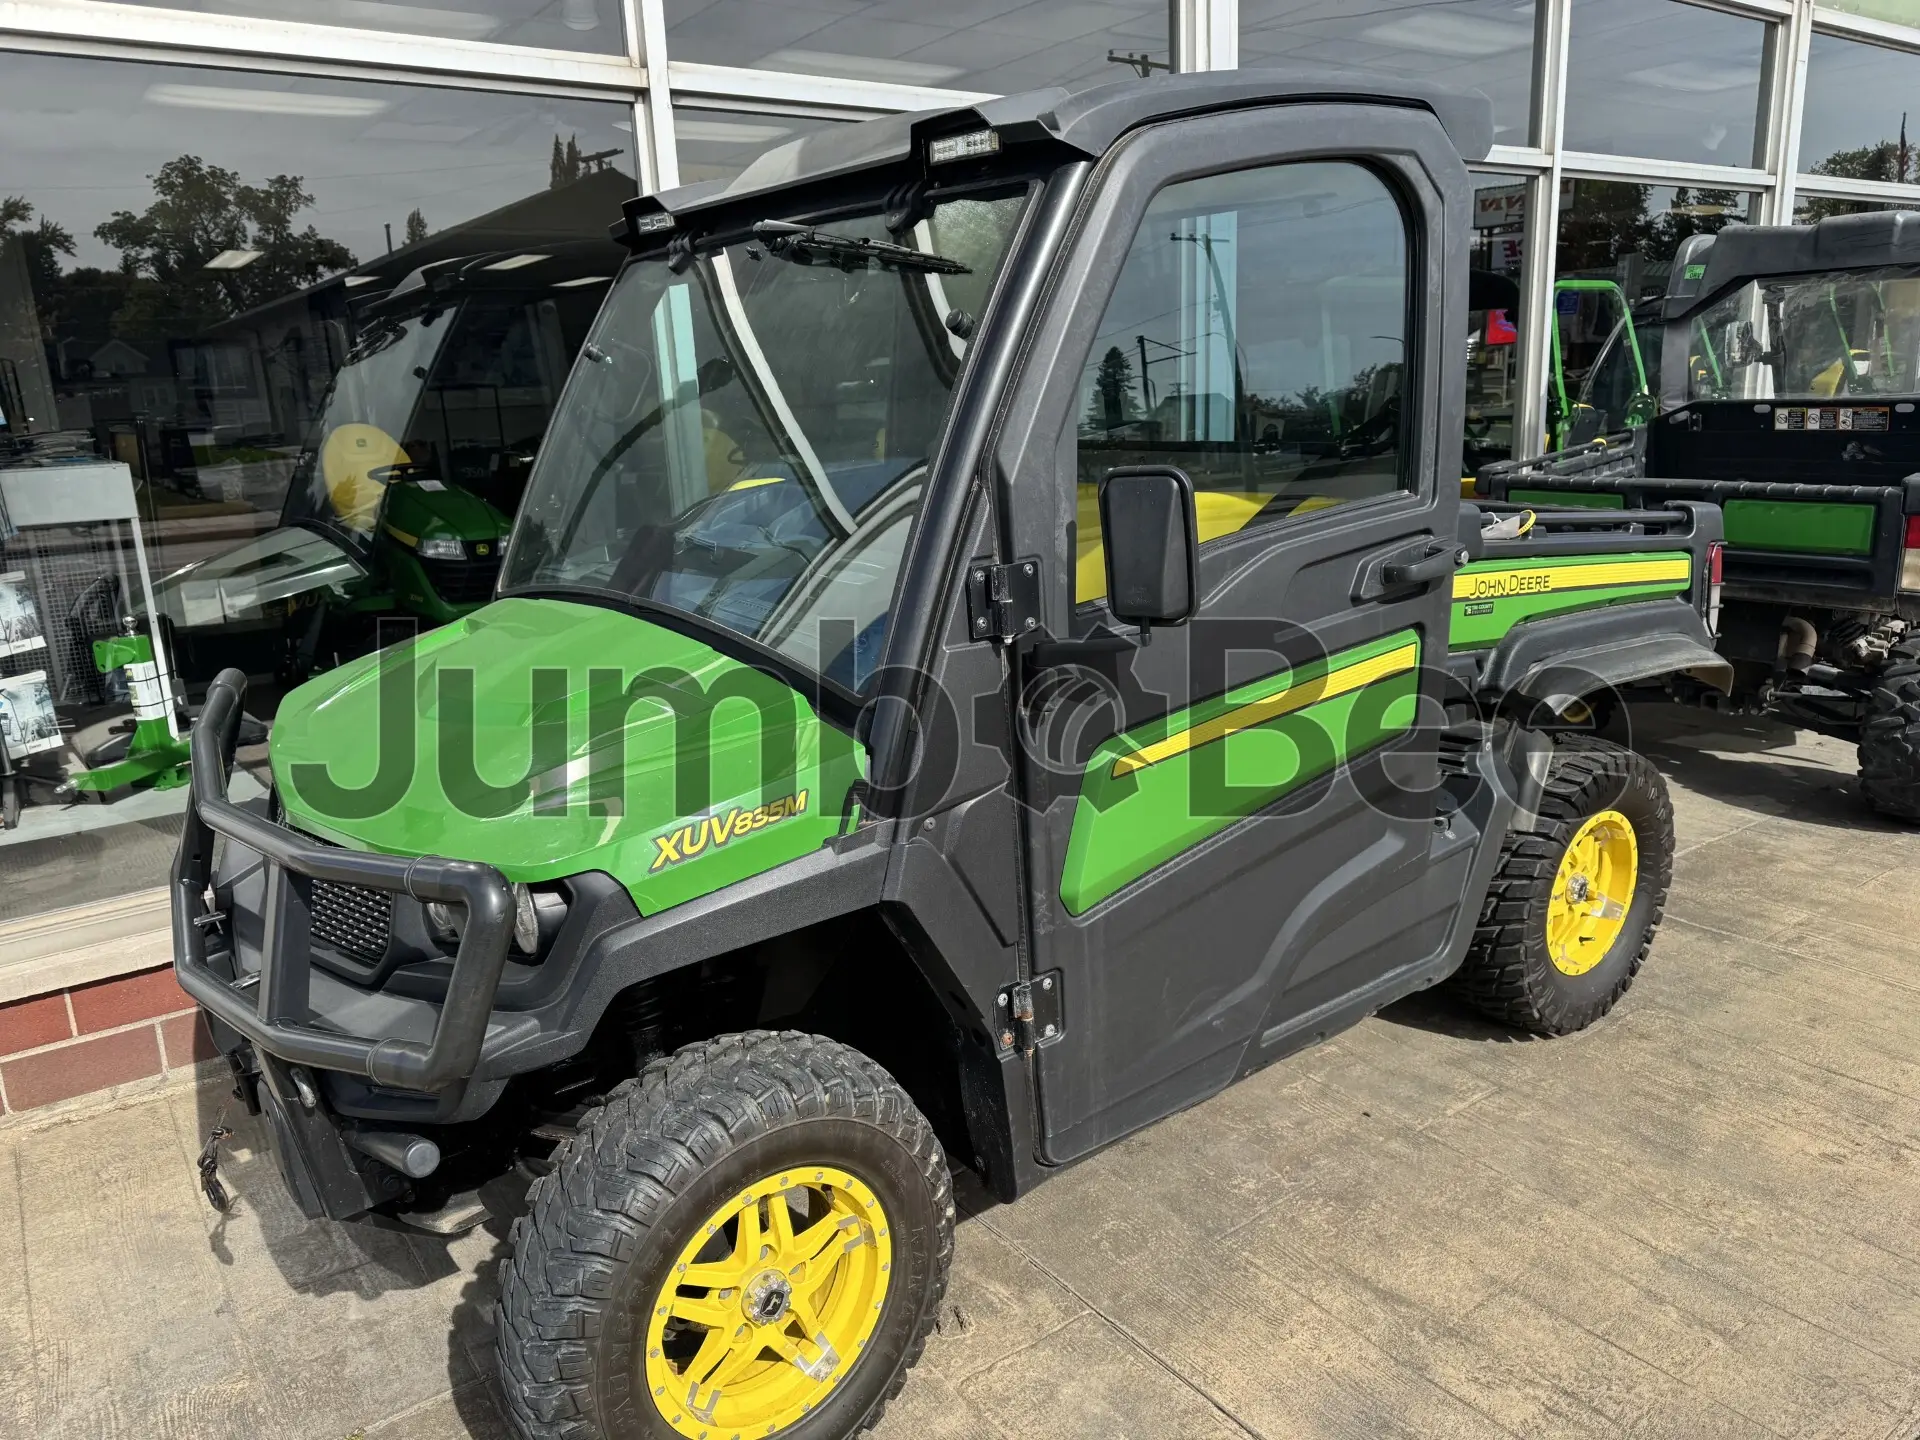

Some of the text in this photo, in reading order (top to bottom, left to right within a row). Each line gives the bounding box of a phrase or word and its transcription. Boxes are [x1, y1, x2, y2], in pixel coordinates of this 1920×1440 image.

[1470, 575, 1550, 596] JOHN DEERE
[650, 789, 809, 872] XUV835M
